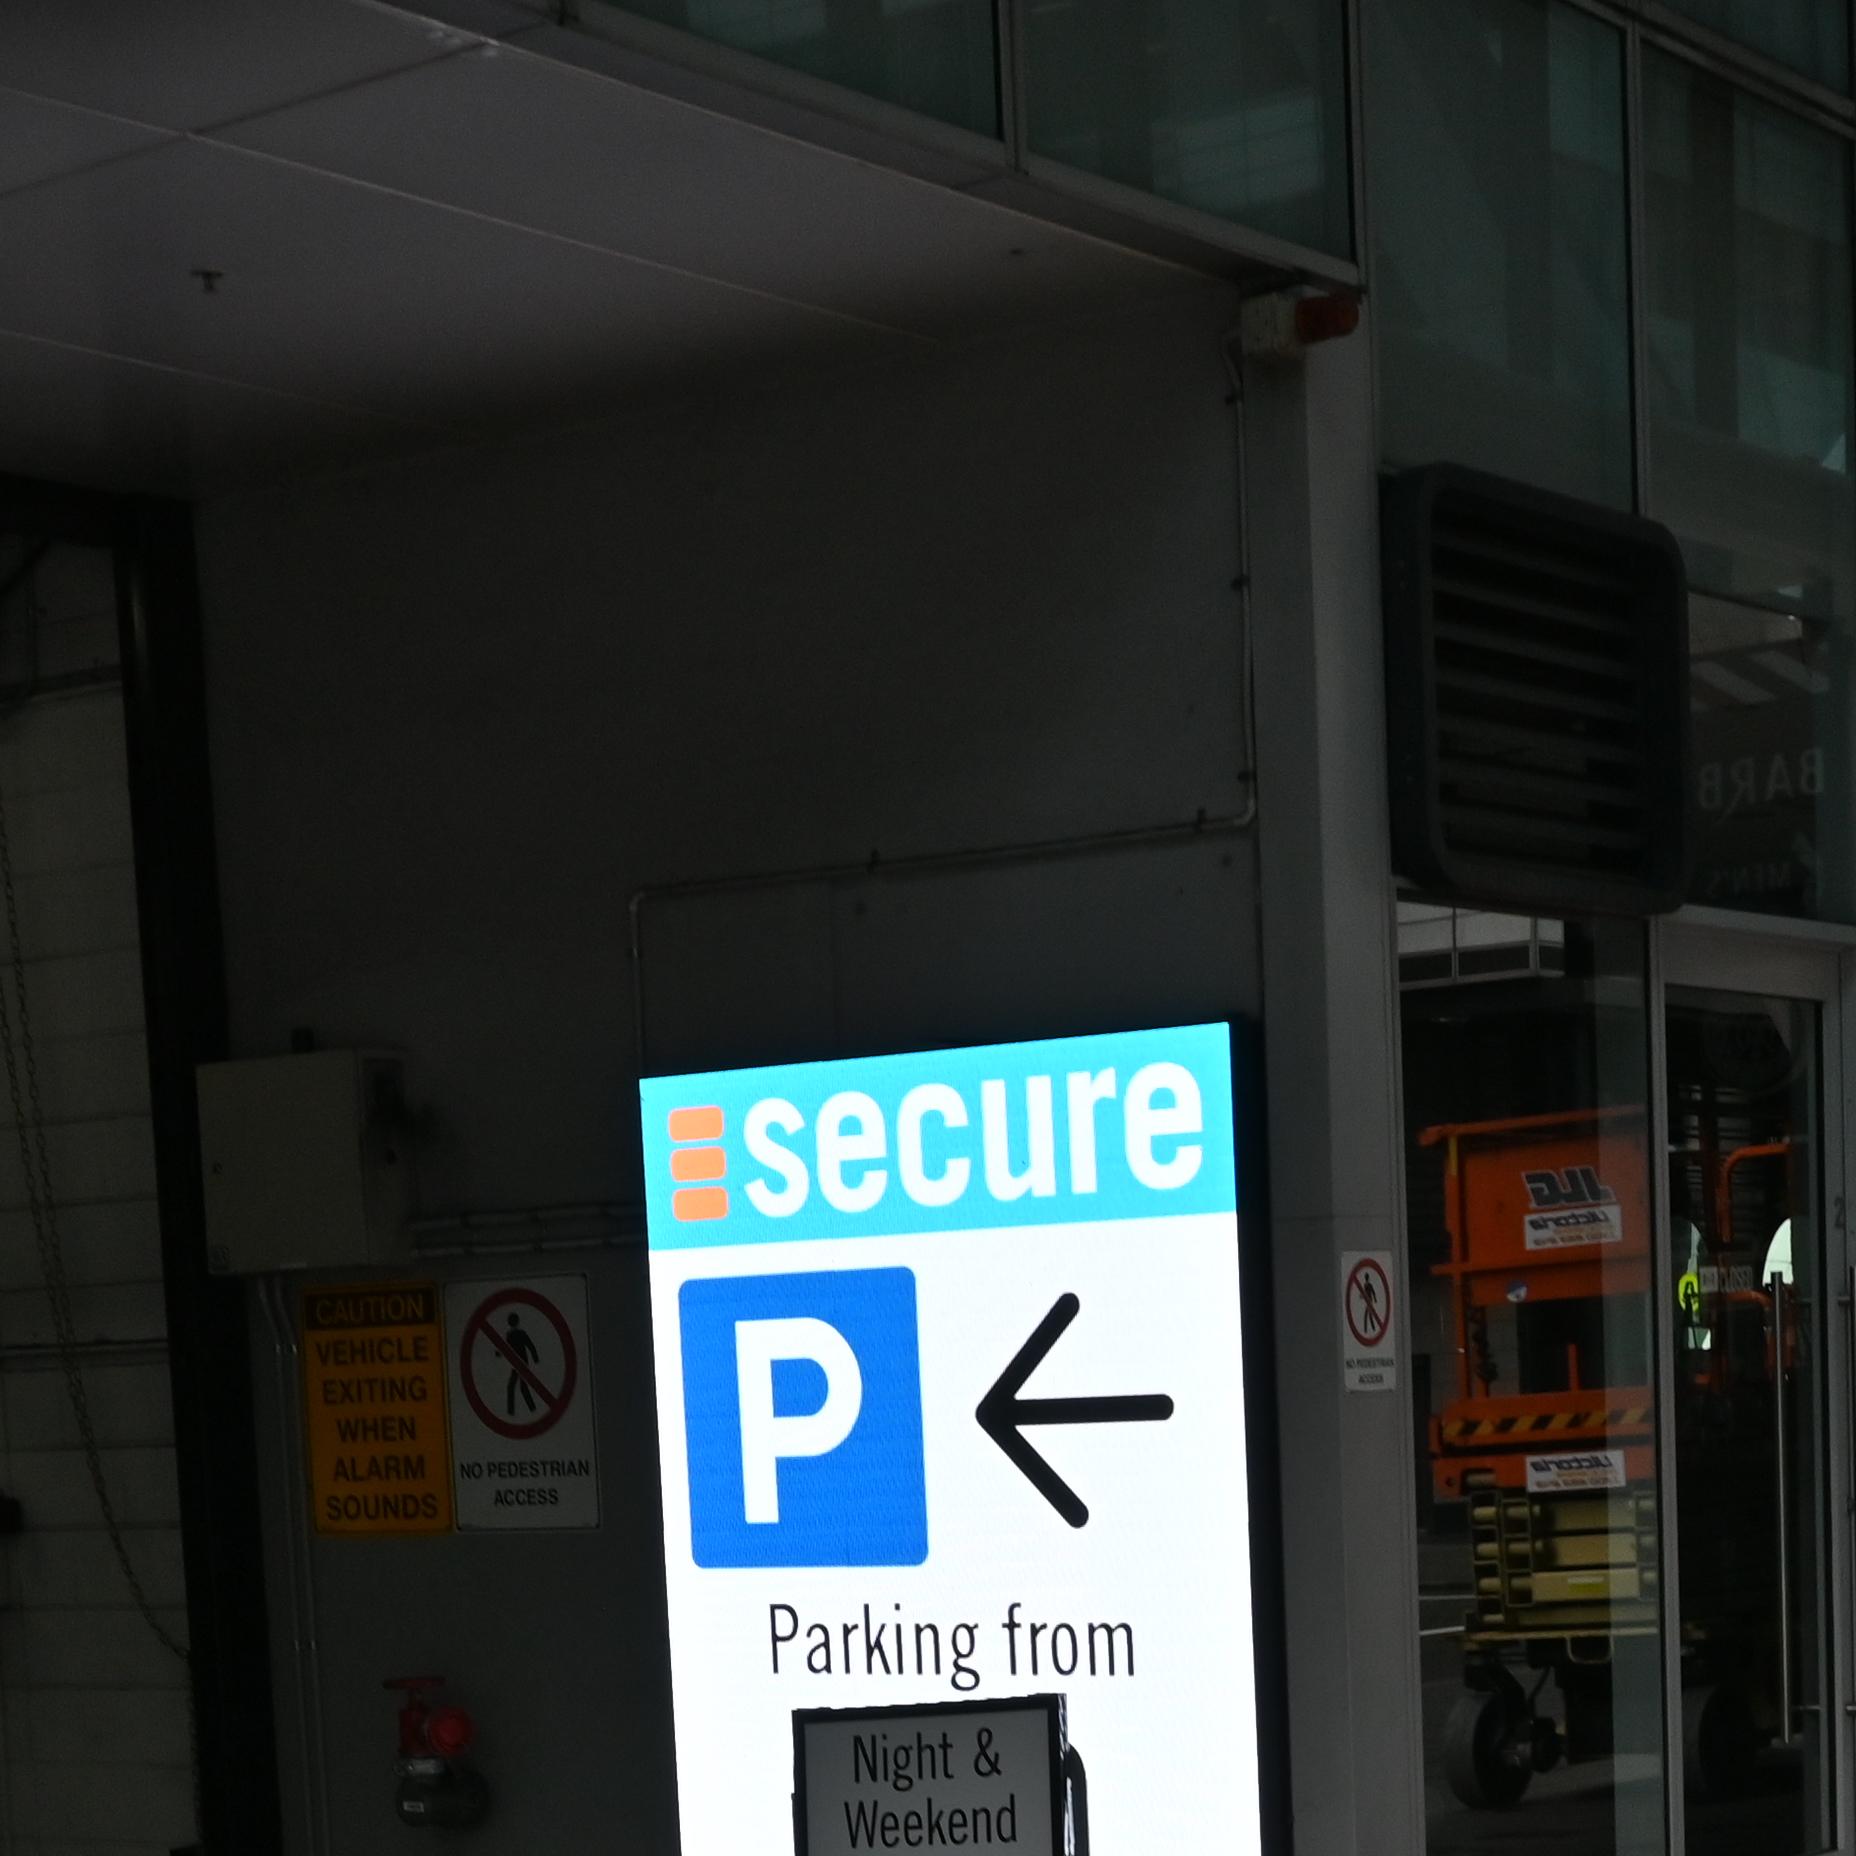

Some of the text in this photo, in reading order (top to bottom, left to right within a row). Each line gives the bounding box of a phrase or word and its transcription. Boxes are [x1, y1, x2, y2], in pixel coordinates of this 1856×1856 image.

[744, 1061, 1204, 1218] secure
[315, 1292, 425, 1326] CAUTION
[315, 1335, 430, 1366] VEHICLE
[322, 1376, 428, 1404] EXITING
[336, 1416, 418, 1443] WHEN
[734, 1316, 863, 1525] P
[333, 1454, 426, 1482] ALARM
[460, 1459, 590, 1480] NO PEDESTRIAN
[325, 1493, 439, 1523] SOUNDS
[494, 1487, 560, 1506] ACCESS
[769, 1602, 1136, 1691] Parking from
[852, 1727, 1002, 1792] Night &
[843, 1793, 1017, 1849] Weekend
